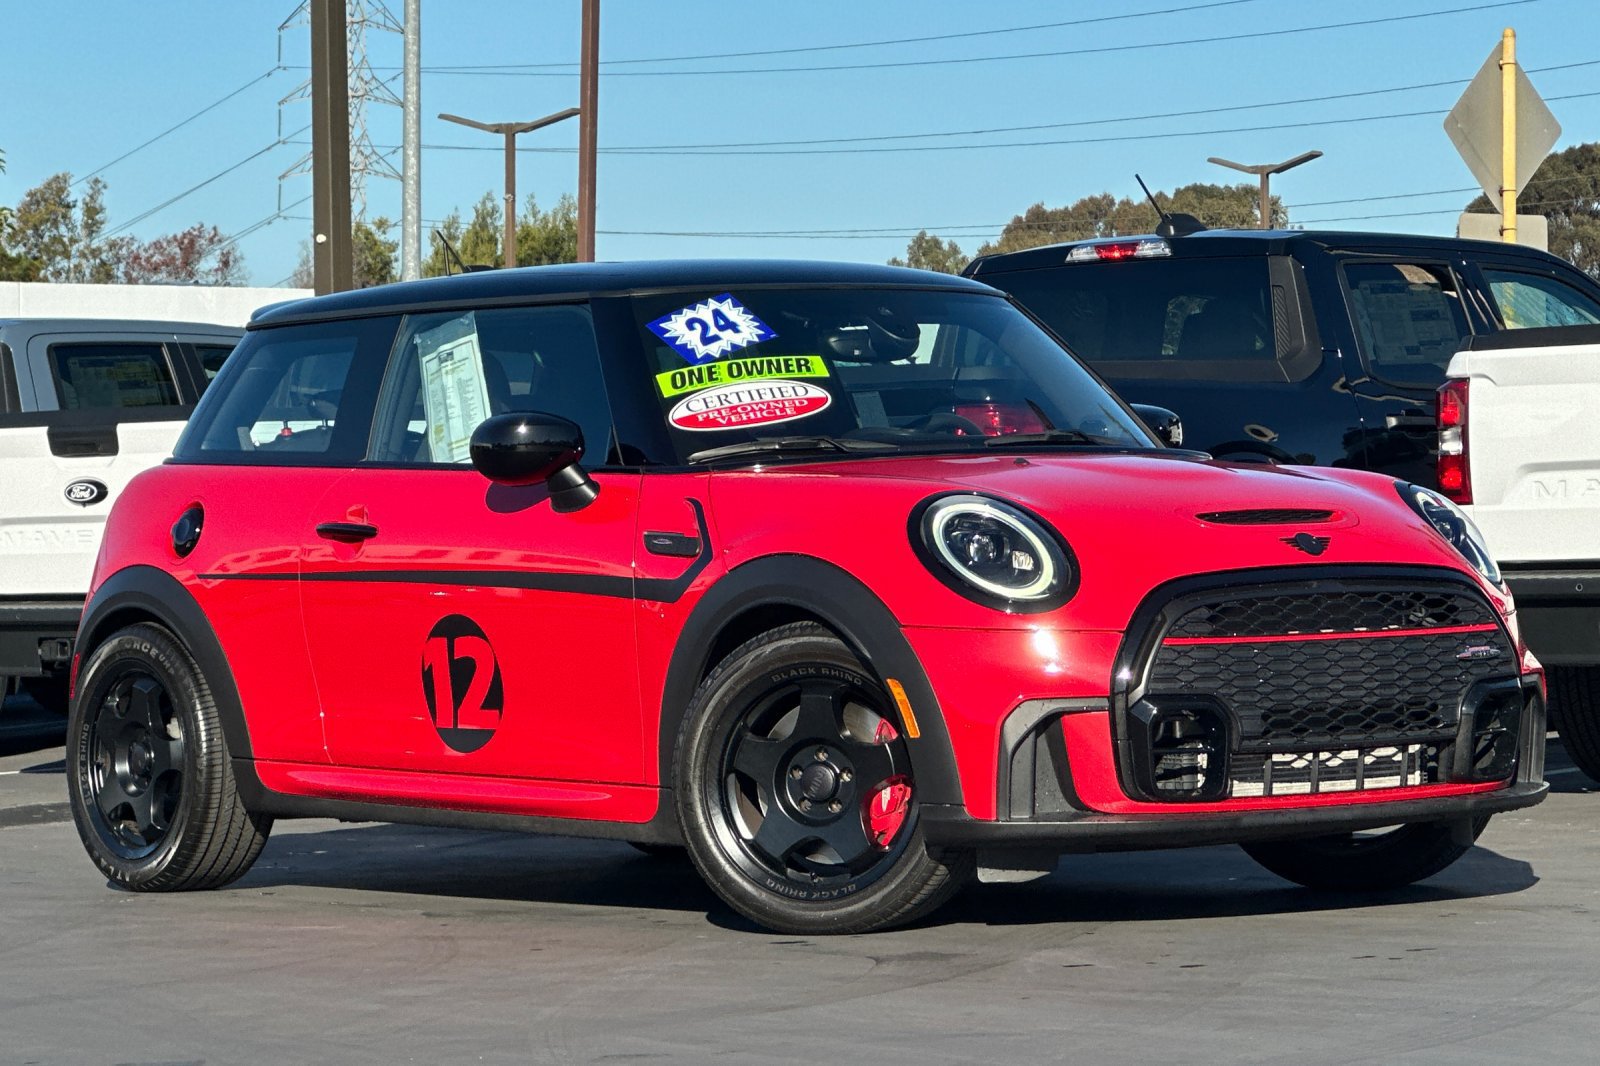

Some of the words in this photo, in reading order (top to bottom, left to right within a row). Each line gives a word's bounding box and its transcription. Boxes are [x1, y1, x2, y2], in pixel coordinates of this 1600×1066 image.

[685, 308, 743, 347] 24
[671, 365, 721, 390] ONE
[727, 357, 814, 380] OWNER
[685, 384, 809, 413] CERTIFIED
[696, 399, 809, 422] PRE-OWNED
[716, 407, 797, 425] VEHICLE
[70, 485, 91, 498] Ford
[119, 640, 159, 660] ORCE
[423, 636, 500, 729] 12
[771, 667, 816, 682] BLACK
[821, 667, 862, 685] RHINO
[80, 723, 90, 762] RHINO
[80, 765, 93, 806] BLACK
[766, 878, 807, 898] RHINO
[811, 883, 856, 898] BLACK
